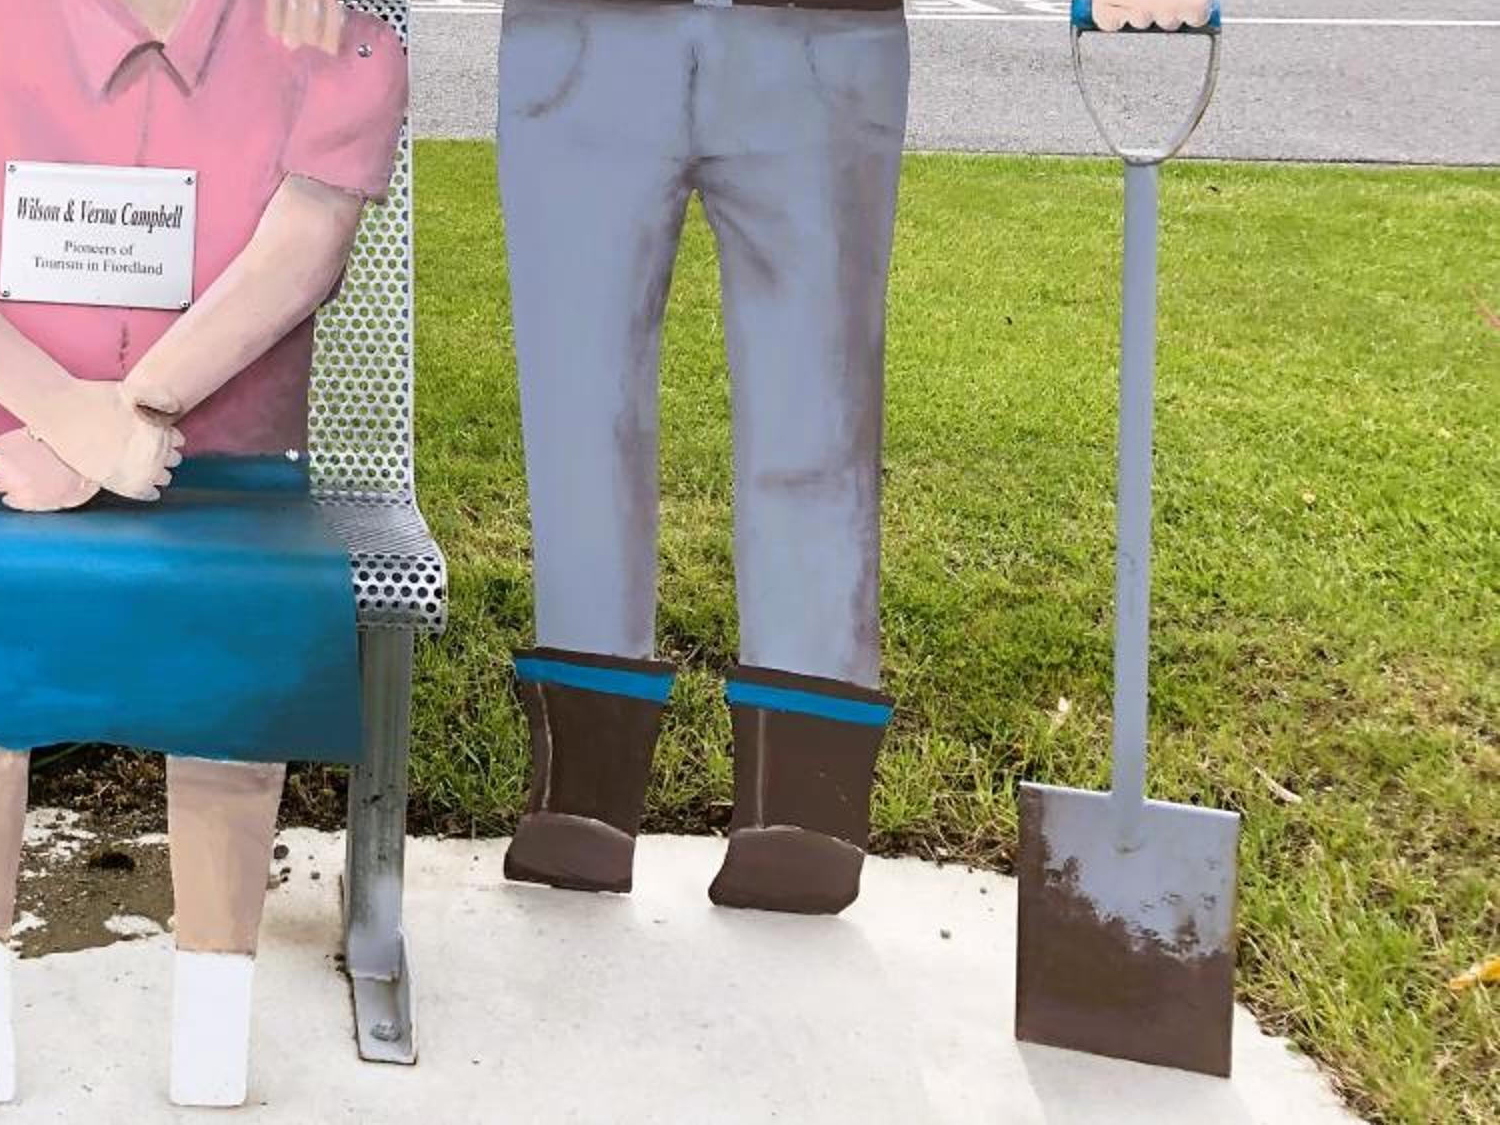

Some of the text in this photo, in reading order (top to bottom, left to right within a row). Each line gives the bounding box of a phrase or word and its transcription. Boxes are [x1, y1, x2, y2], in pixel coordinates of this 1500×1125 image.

[17, 196, 183, 233] Wilson & Verna Campbell
[64, 240, 134, 256] Pioneers of
[34, 256, 163, 276] Tourism in Fiordland
